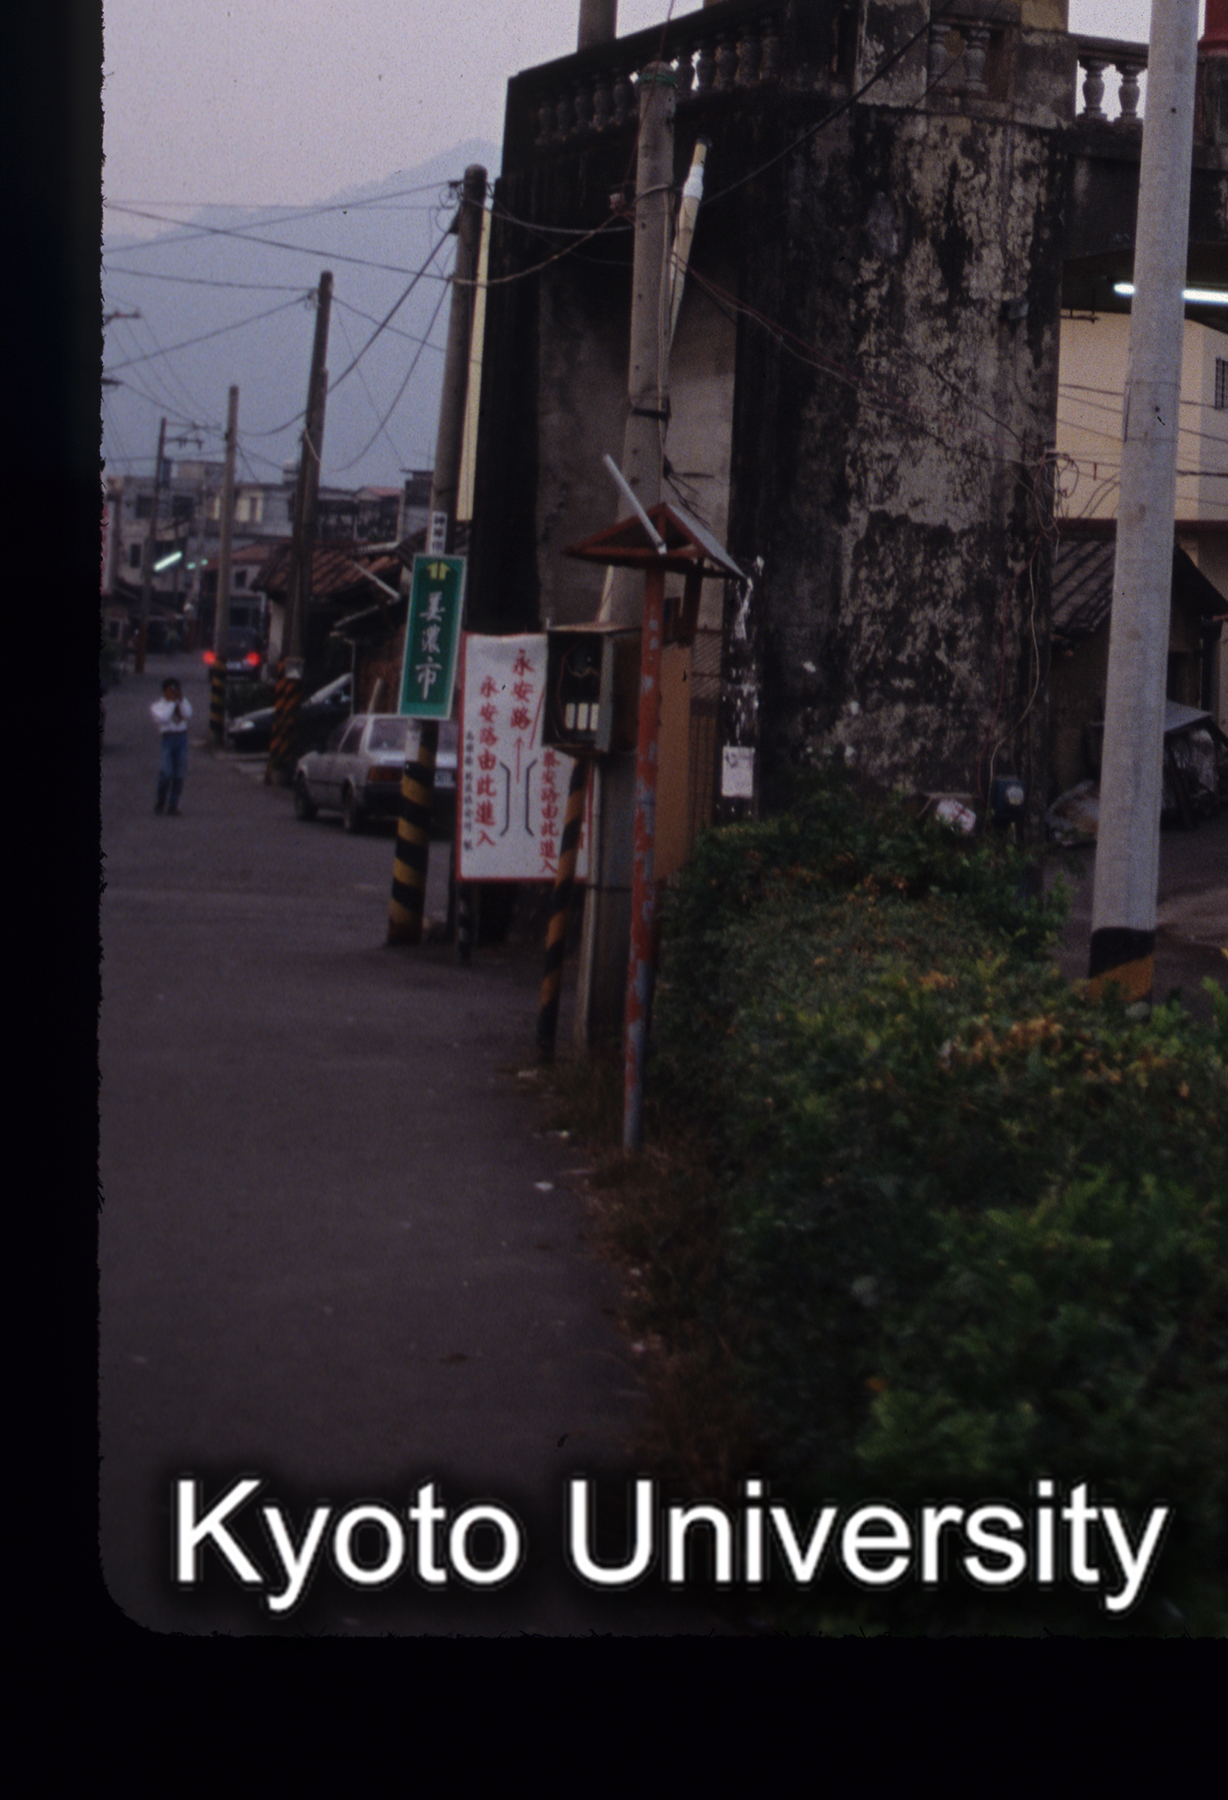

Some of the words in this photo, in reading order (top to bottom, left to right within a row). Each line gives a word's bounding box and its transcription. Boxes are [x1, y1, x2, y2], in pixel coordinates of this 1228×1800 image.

[510, 648, 534, 731] 永安路
[475, 675, 499, 847] 永安路由此進入
